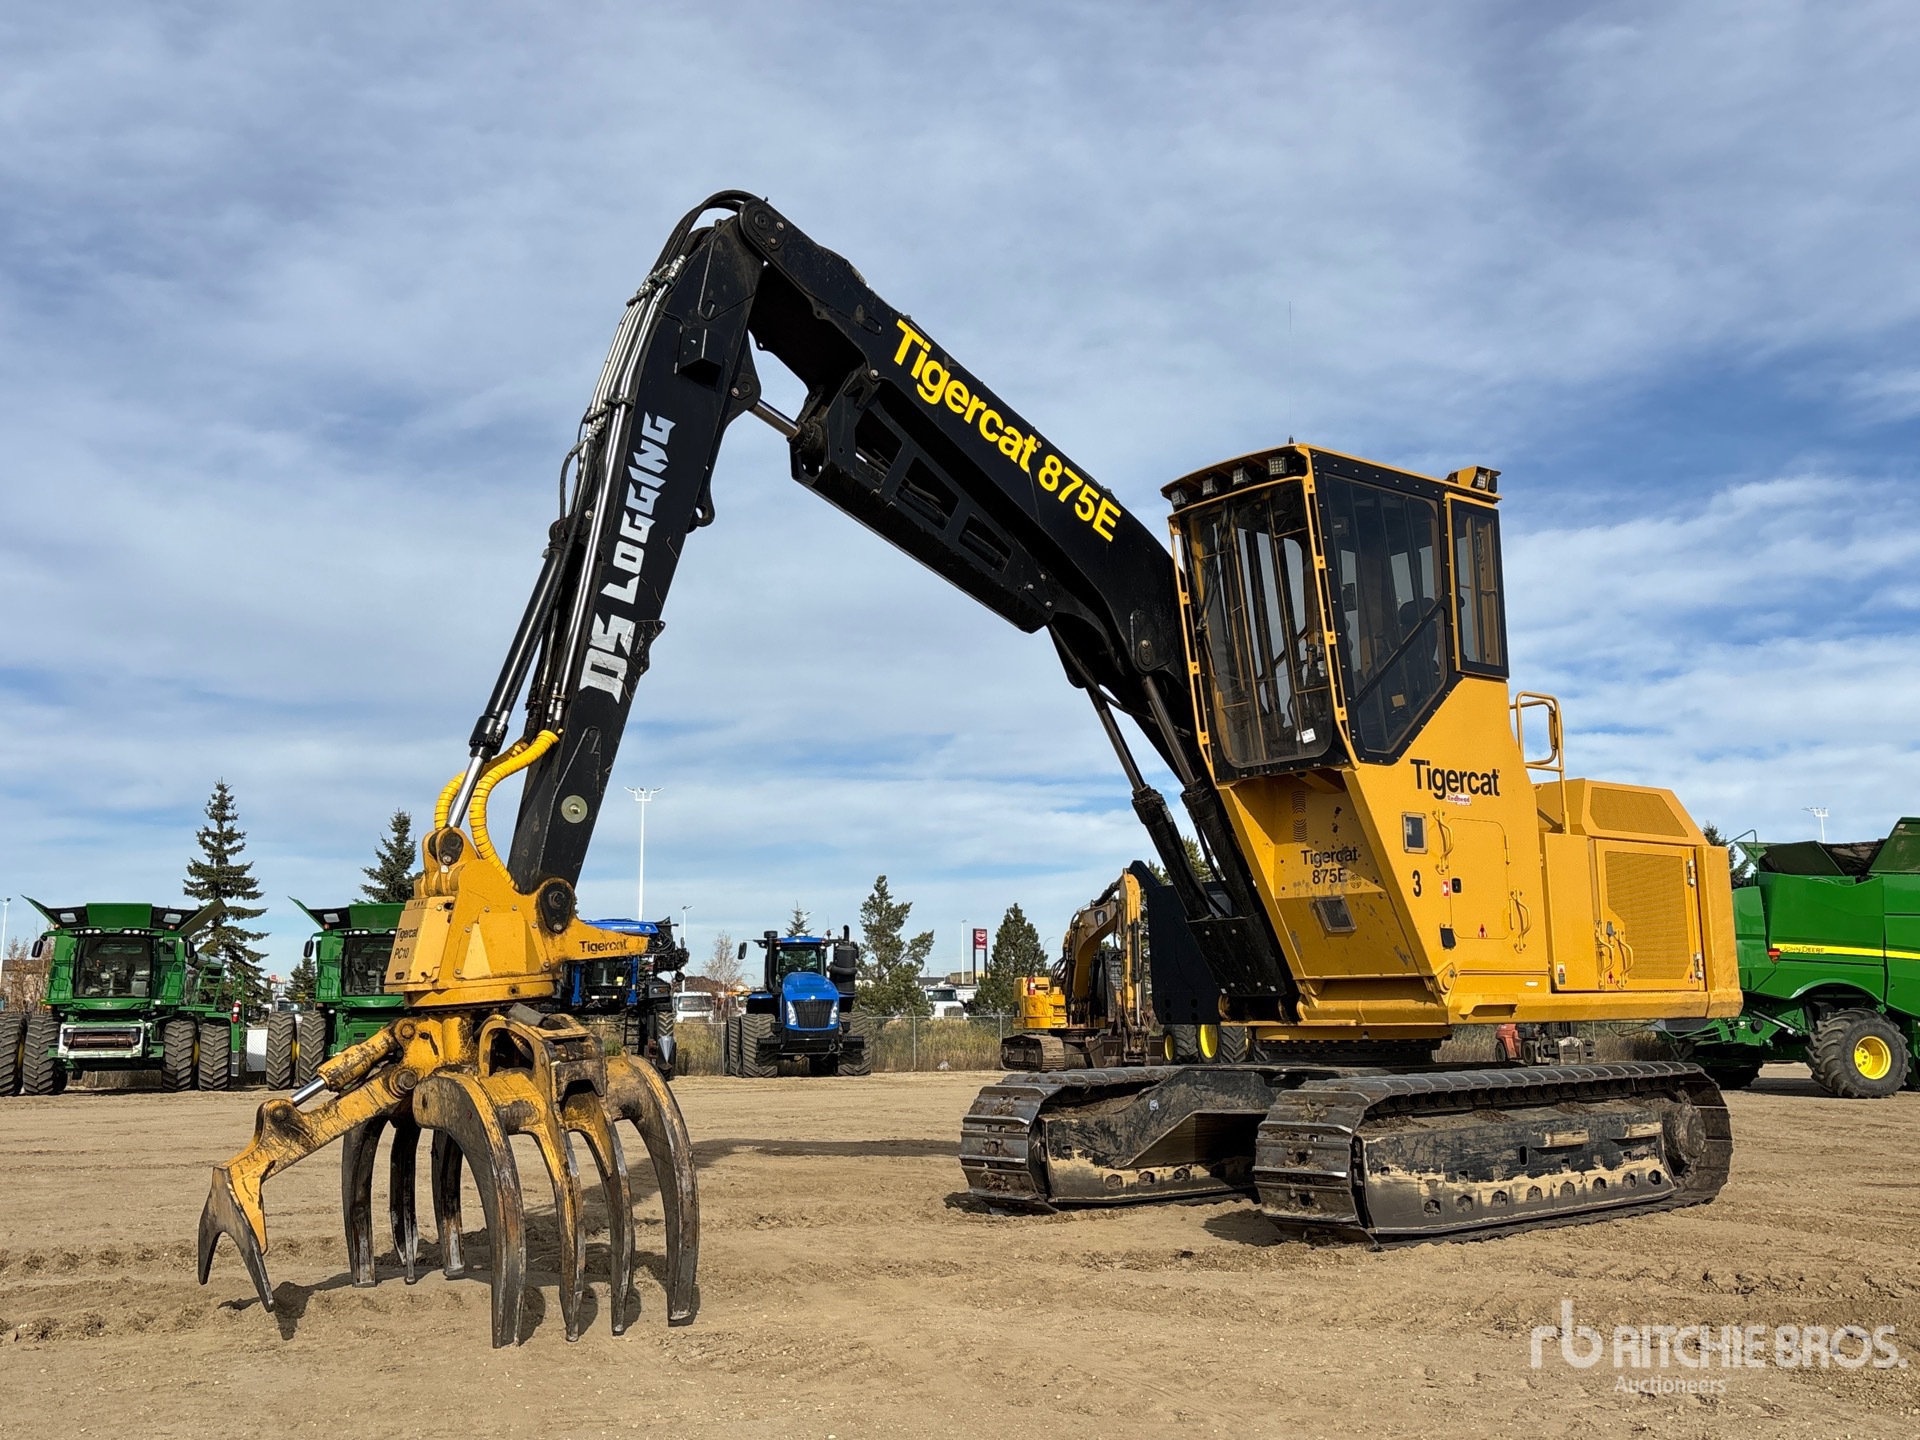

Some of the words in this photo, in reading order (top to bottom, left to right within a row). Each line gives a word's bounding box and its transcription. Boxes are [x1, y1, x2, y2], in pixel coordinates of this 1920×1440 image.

[893, 319, 1038, 473] Tigercat
[1039, 454, 1121, 542] 875E
[600, 411, 676, 605] LOGGING
[578, 612, 636, 704] DS
[1410, 758, 1500, 800] Tigercat
[1300, 846, 1358, 868] Tigercat
[1312, 867, 1347, 885] 875E
[1412, 869, 1422, 898] 3
[397, 927, 418, 942] Tigercat
[578, 938, 628, 954] Tigercat
[393, 947, 410, 960] PC10
